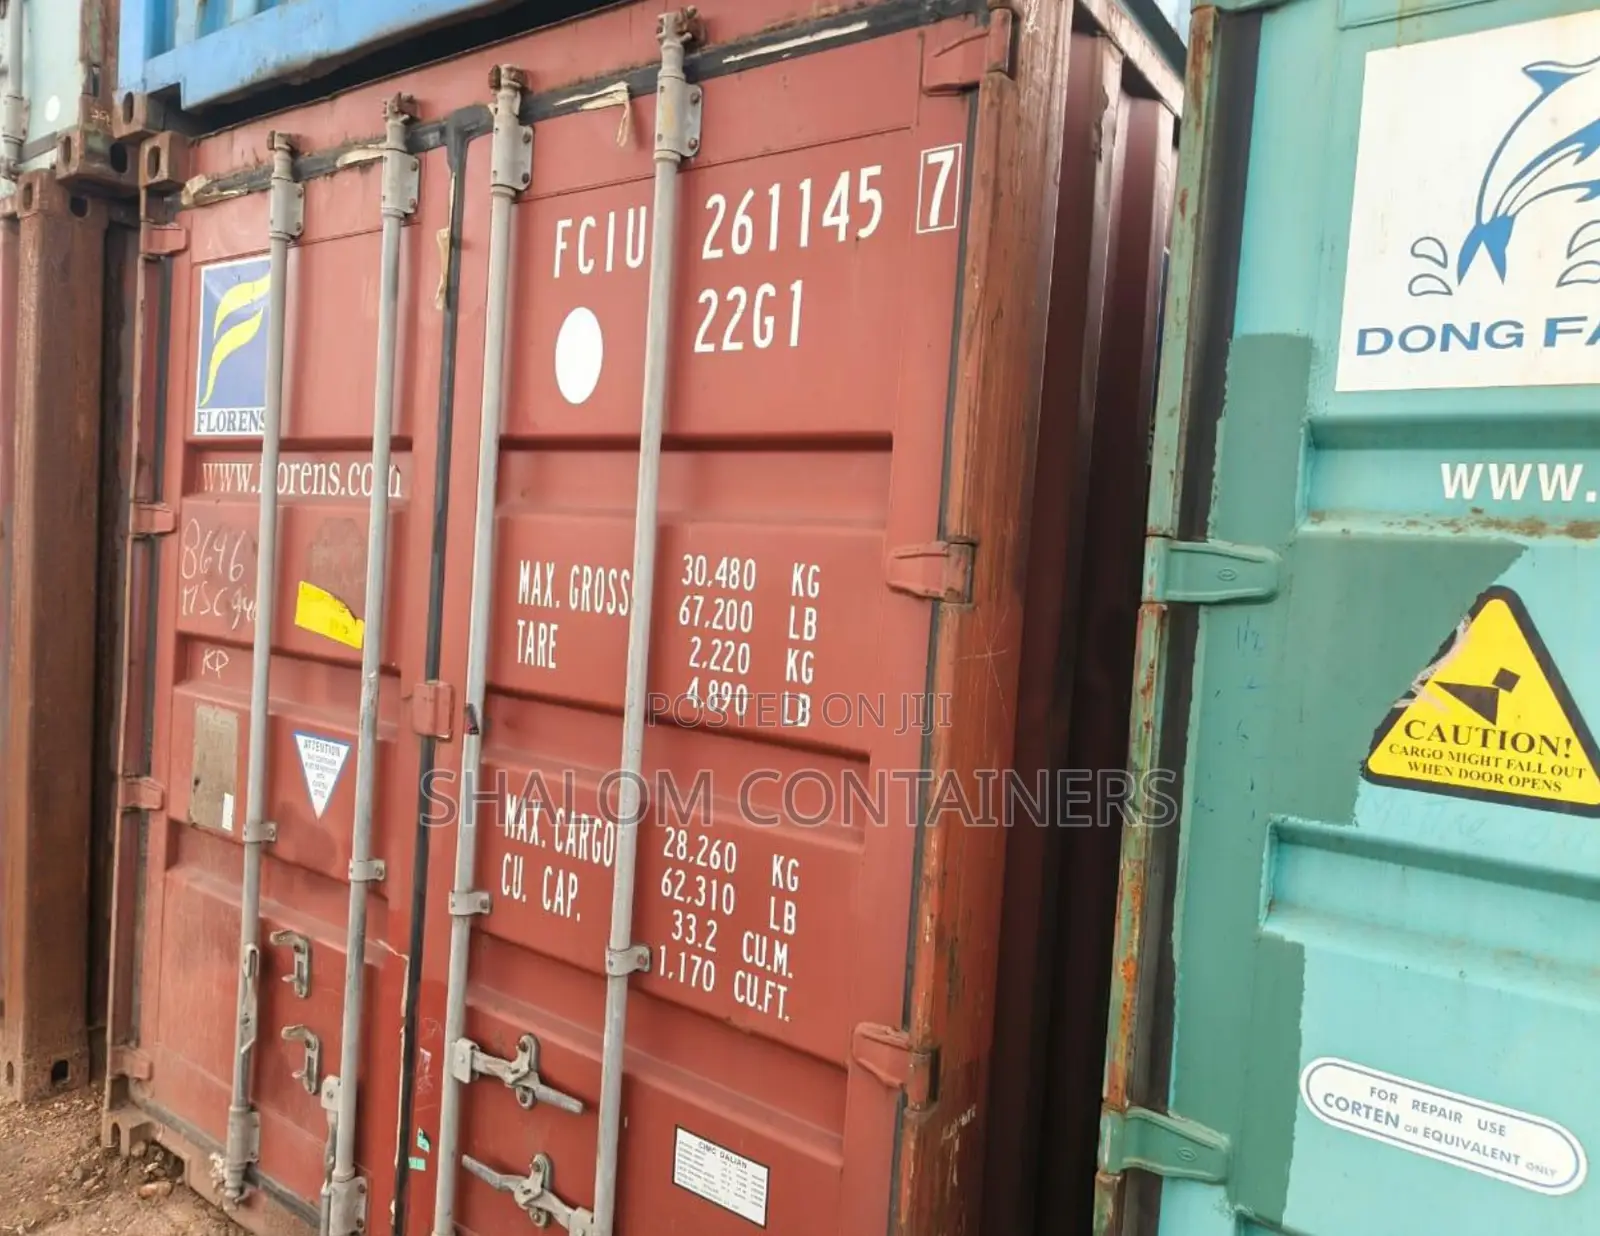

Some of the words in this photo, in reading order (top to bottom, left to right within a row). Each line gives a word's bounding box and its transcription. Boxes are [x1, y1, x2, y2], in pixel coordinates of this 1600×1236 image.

[553, 205, 647, 279] FCIU
[701, 164, 883, 260] 261145
[925, 148, 957, 228] 7
[693, 279, 804, 353] 22G1
[1356, 319, 1525, 356] DONG
[518, 560, 560, 609] MAX.
[568, 563, 631, 617] GROSS
[791, 562, 821, 598] KG
[788, 605, 818, 642] LB
[517, 619, 559, 669] TARE
[785, 647, 815, 686] KG
[783, 690, 811, 728] LB
[1388, 742, 1444, 760] CARGO
[1447, 750, 1502, 769] MIGHT
[1506, 757, 1547, 775] FALL
[1550, 764, 1587, 780] OUT
[1403, 719, 1573, 760] CAUTION!
[1407, 760, 1454, 777] WHEN
[1458, 767, 1505, 786] DOOR
[1508, 773, 1563, 793] OPENS
[504, 793, 546, 849] MAX.
[554, 807, 615, 868] CARGO
[771, 853, 800, 892] KG
[501, 852, 527, 903] CU.
[541, 864, 581, 923] CAP.
[671, 909, 718, 953] 33.2
[742, 930, 794, 979] CU.M.
[769, 895, 797, 936] LB
[733, 969, 791, 1023] CU.FT.
[1322, 1091, 1401, 1129] CORTEN
[1403, 1124, 1419, 1135] OR
[1422, 1126, 1522, 1167] EQUIVALENT
[1525, 1161, 1558, 1178] ONLY
[1369, 1085, 1398, 1105] FOR
[1411, 1099, 1463, 1125] REPAIR
[1477, 1118, 1507, 1138] USE
